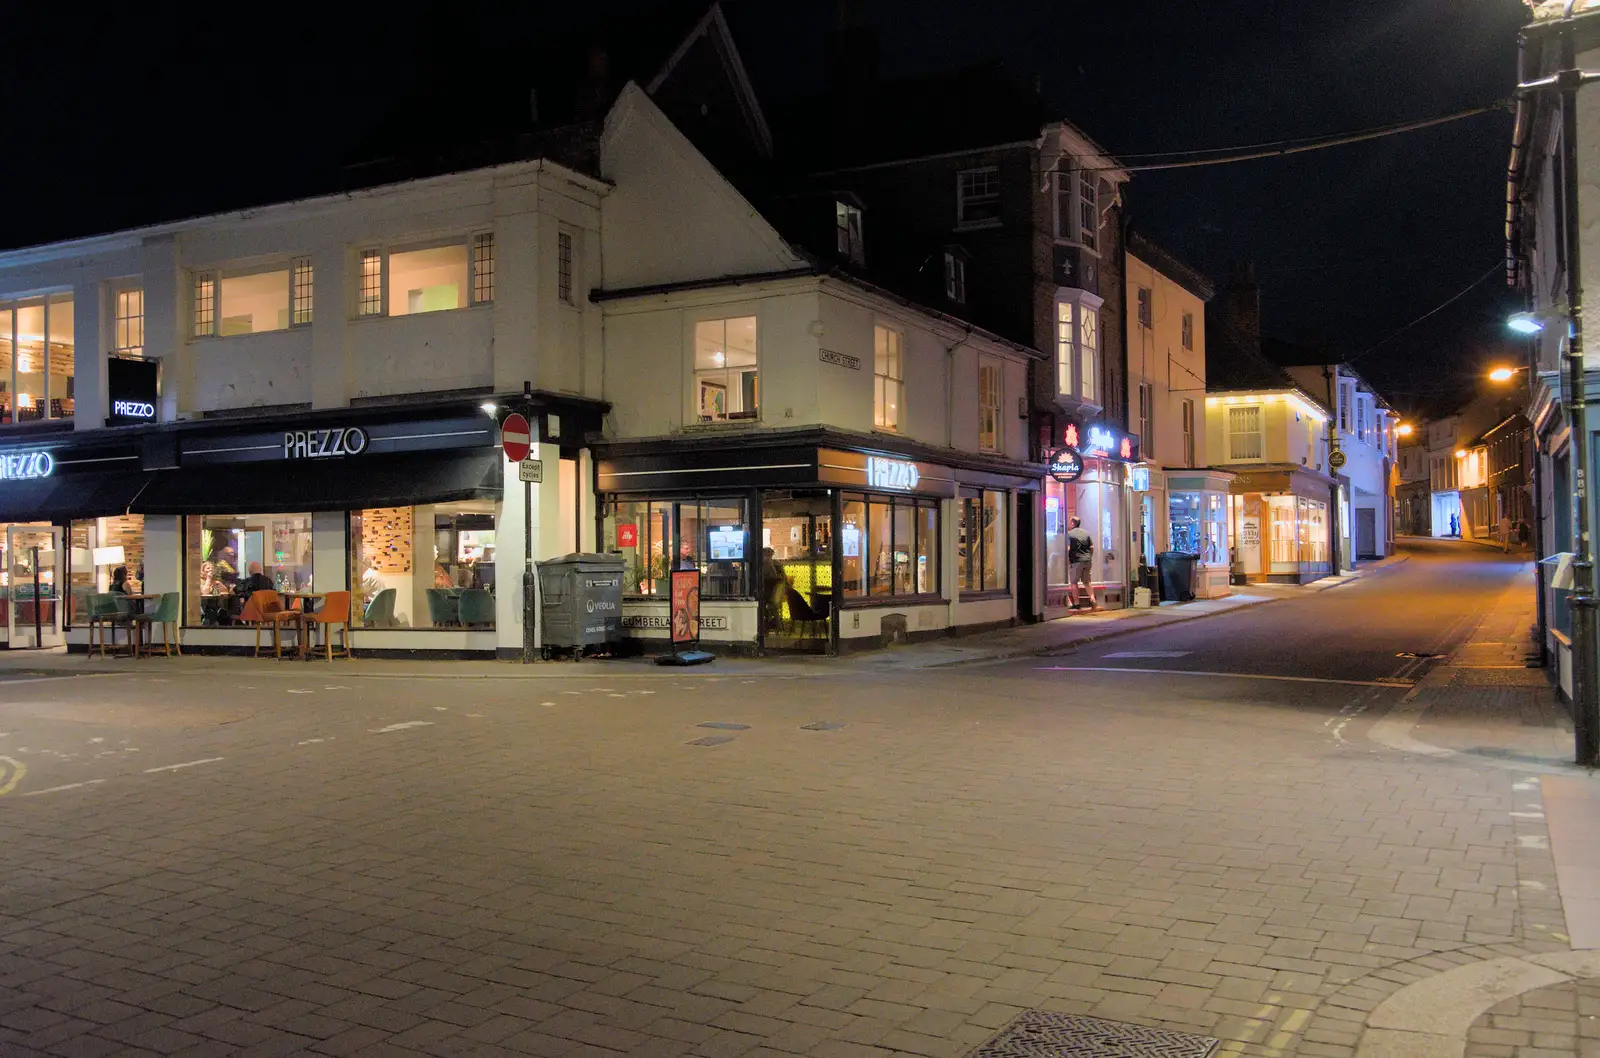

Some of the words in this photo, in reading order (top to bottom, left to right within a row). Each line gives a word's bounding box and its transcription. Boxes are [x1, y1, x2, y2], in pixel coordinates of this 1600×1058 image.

[822, 350, 841, 364] CHURCH
[842, 355, 859, 369] STREET
[114, 400, 154, 417] PREZZO
[284, 427, 365, 459] PREZZO
[0, 451, 54, 480] REZZO
[522, 462, 540, 471] Except
[1051, 463, 1080, 473] Shapla
[523, 471, 539, 479] cycles
[1230, 476, 1252, 485] ENS
[595, 602, 615, 610] VEOLIA
[622, 617, 671, 627] CUMBERLA
[699, 617, 723, 628] REET
